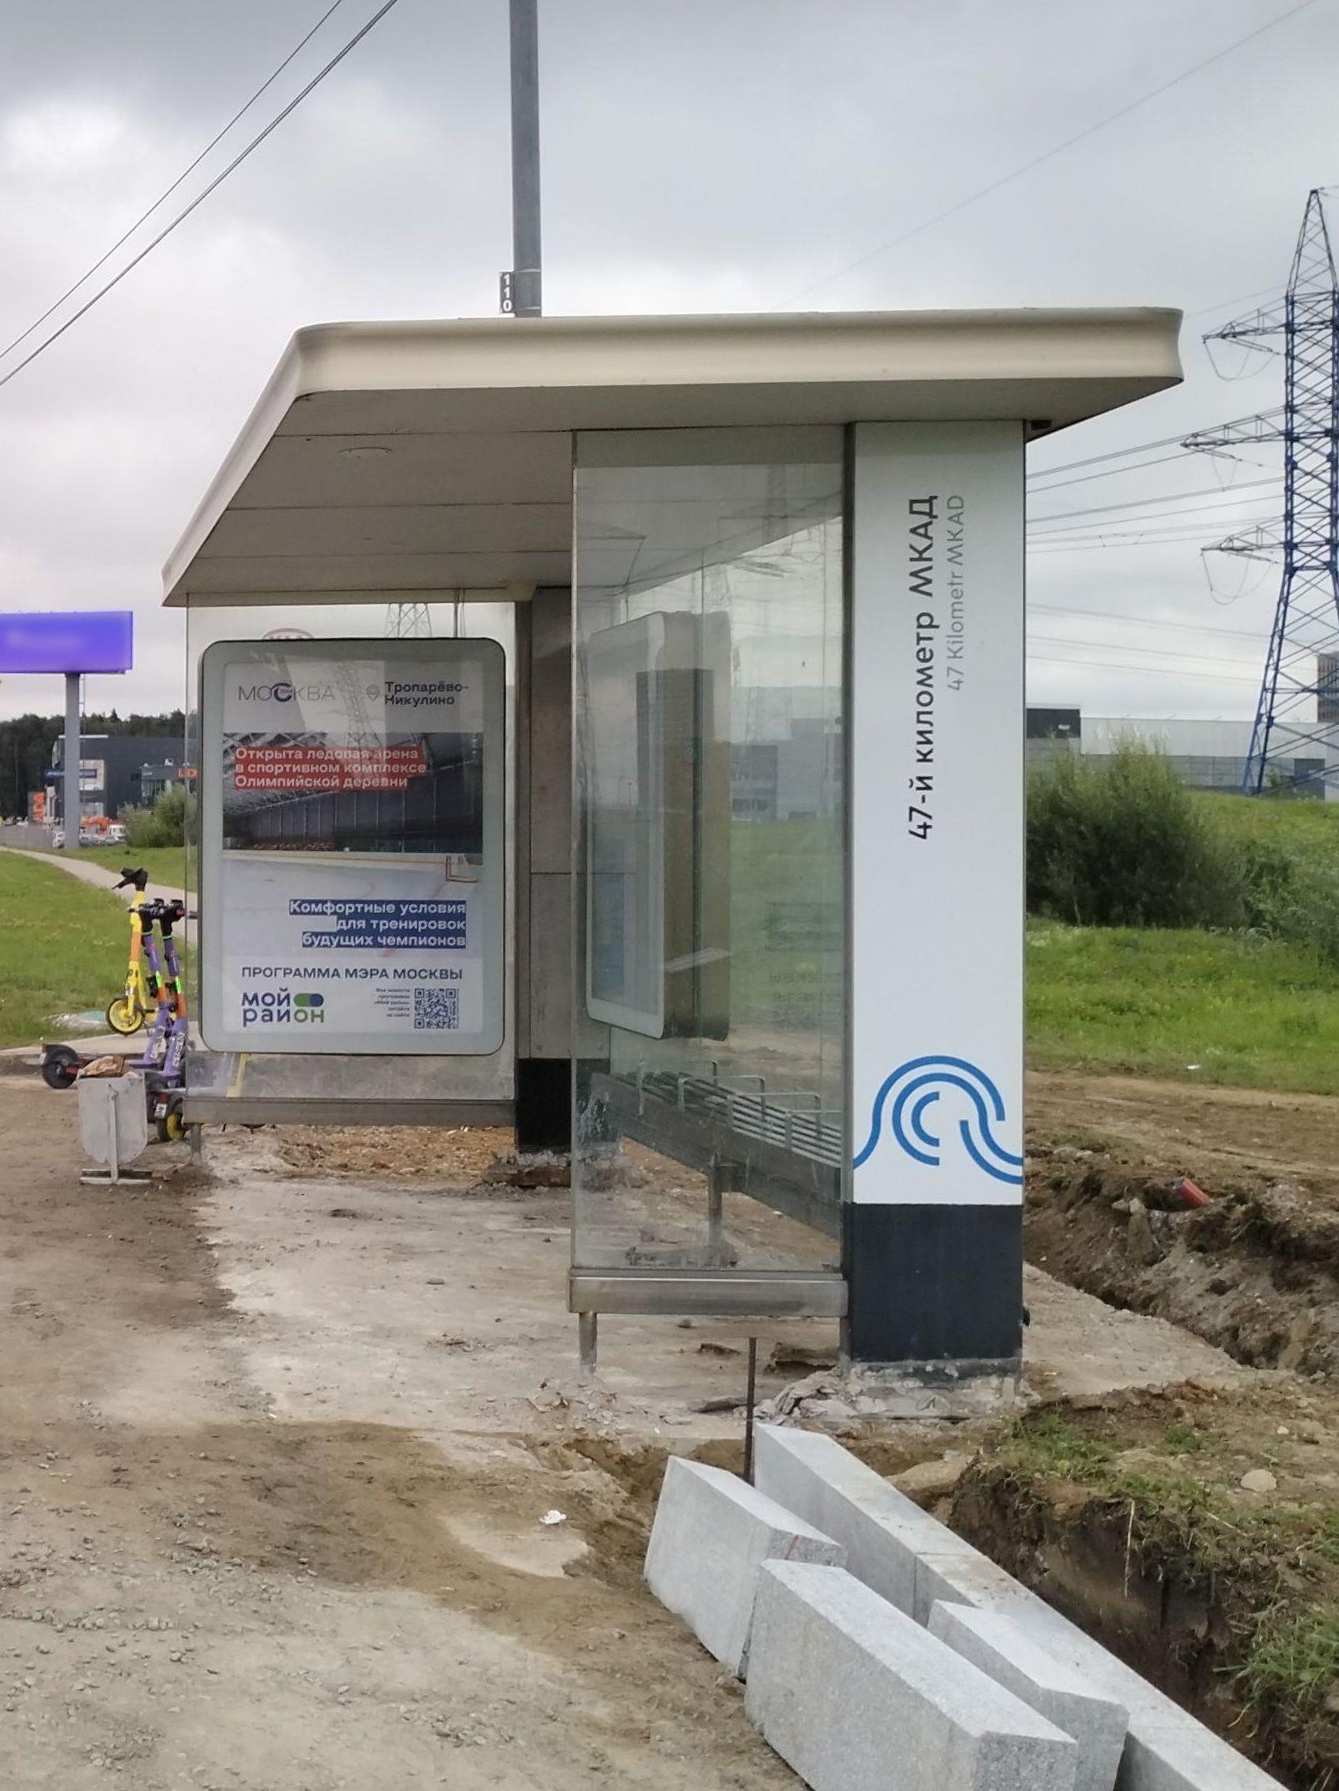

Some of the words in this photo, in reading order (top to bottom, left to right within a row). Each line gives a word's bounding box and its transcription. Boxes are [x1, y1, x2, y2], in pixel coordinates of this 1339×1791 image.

[503, 273, 512, 312] 110
[946, 494, 964, 566] MKAD
[908, 495, 939, 598] МКАД
[946, 571, 964, 659] Kilometr
[915, 611, 940, 763] километр
[946, 666, 964, 691] 47
[238, 683, 335, 702] МОСКВА
[384, 681, 469, 695] Тропарёво-
[384, 695, 455, 708] Никулино
[235, 747, 302, 761] Открыта
[307, 750, 369, 760] ледовая
[373, 750, 419, 761] арена
[235, 764, 244, 773] в
[247, 763, 340, 775] спортивном
[344, 764, 427, 773] комплексе
[235, 775, 340, 787] Олимпийской
[343, 778, 408, 789] деревни
[908, 775, 934, 840] 47-й
[290, 901, 396, 915] Комфортные
[399, 904, 466, 916] условия
[337, 920, 366, 931] для
[370, 920, 466, 932] тренировок
[302, 933, 374, 947] будущих
[377, 936, 466, 946] чемпионов
[241, 966, 341, 979] ПРОГРАММА
[345, 968, 389, 979] МЭРА
[393, 969, 463, 980] МОСКВЫ
[241, 987, 291, 1007] мой
